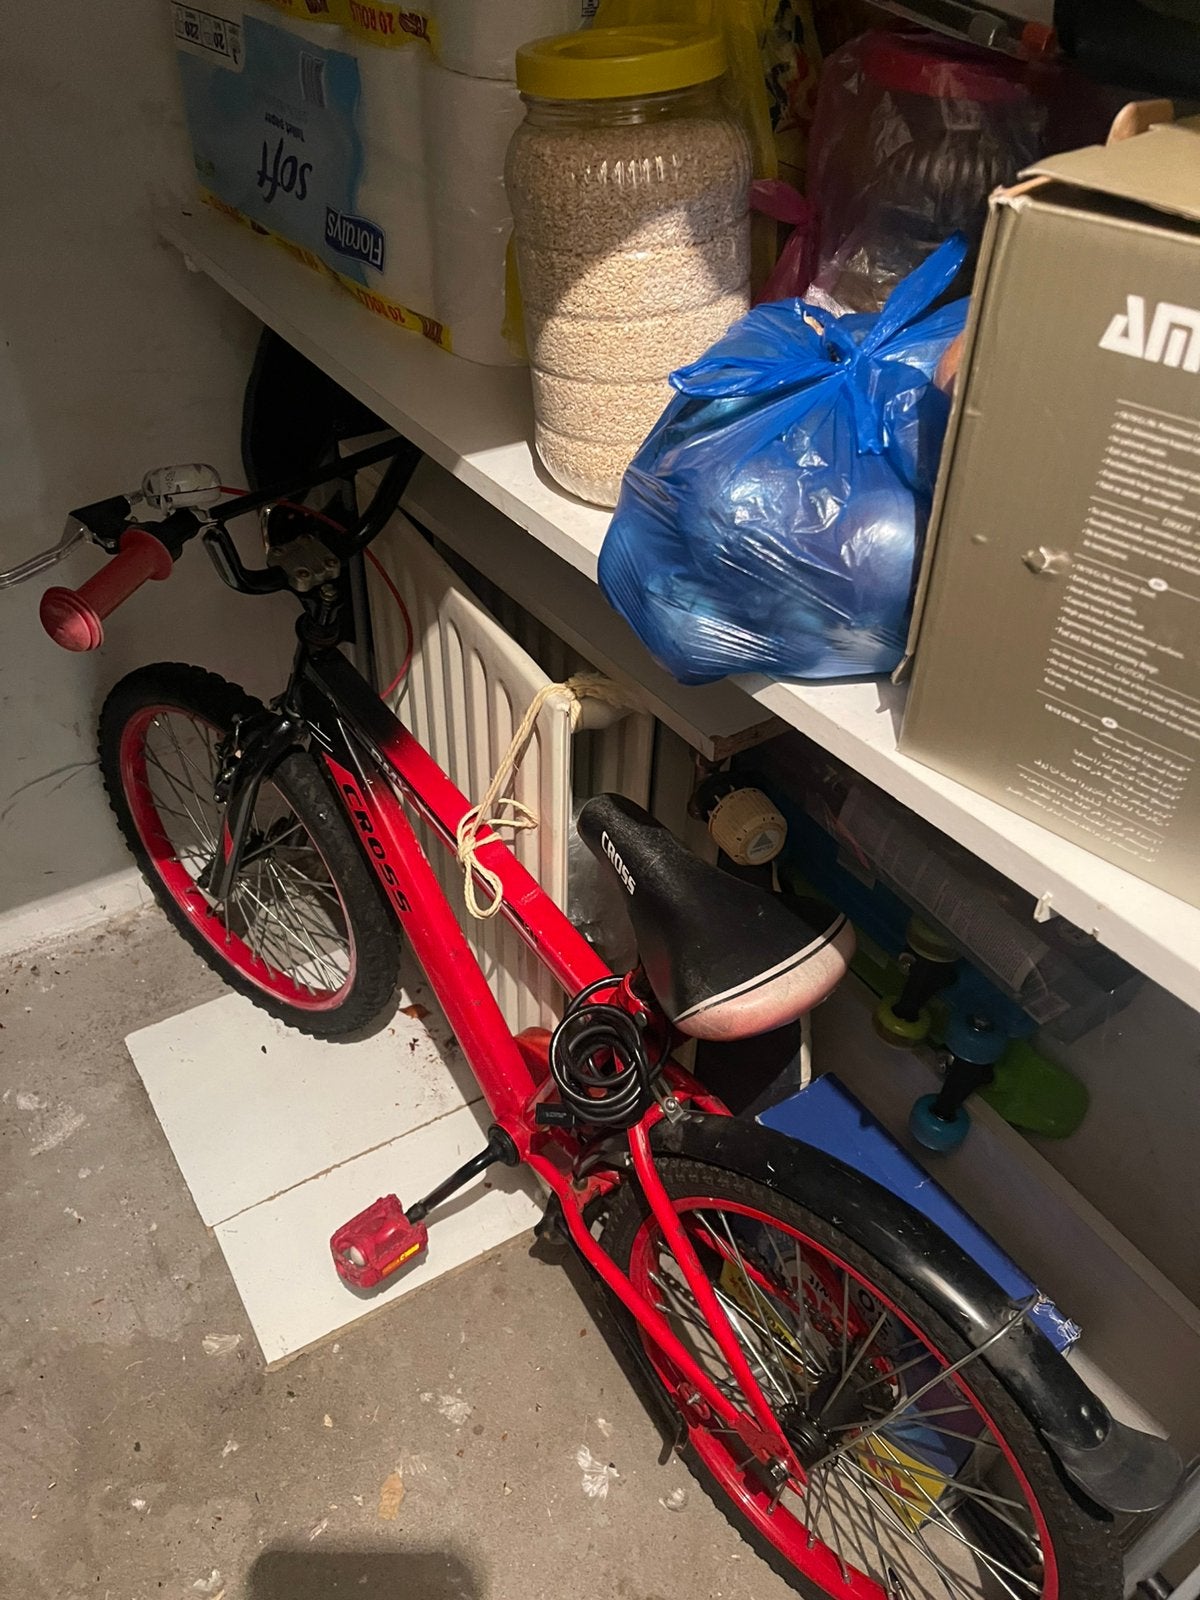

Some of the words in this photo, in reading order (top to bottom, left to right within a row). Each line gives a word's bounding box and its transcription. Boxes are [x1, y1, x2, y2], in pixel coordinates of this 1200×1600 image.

[256, 137, 313, 204] soft
[326, 211, 383, 266] Floralys
[341, 782, 413, 913] CROSS
[600, 830, 638, 896] CROSS
